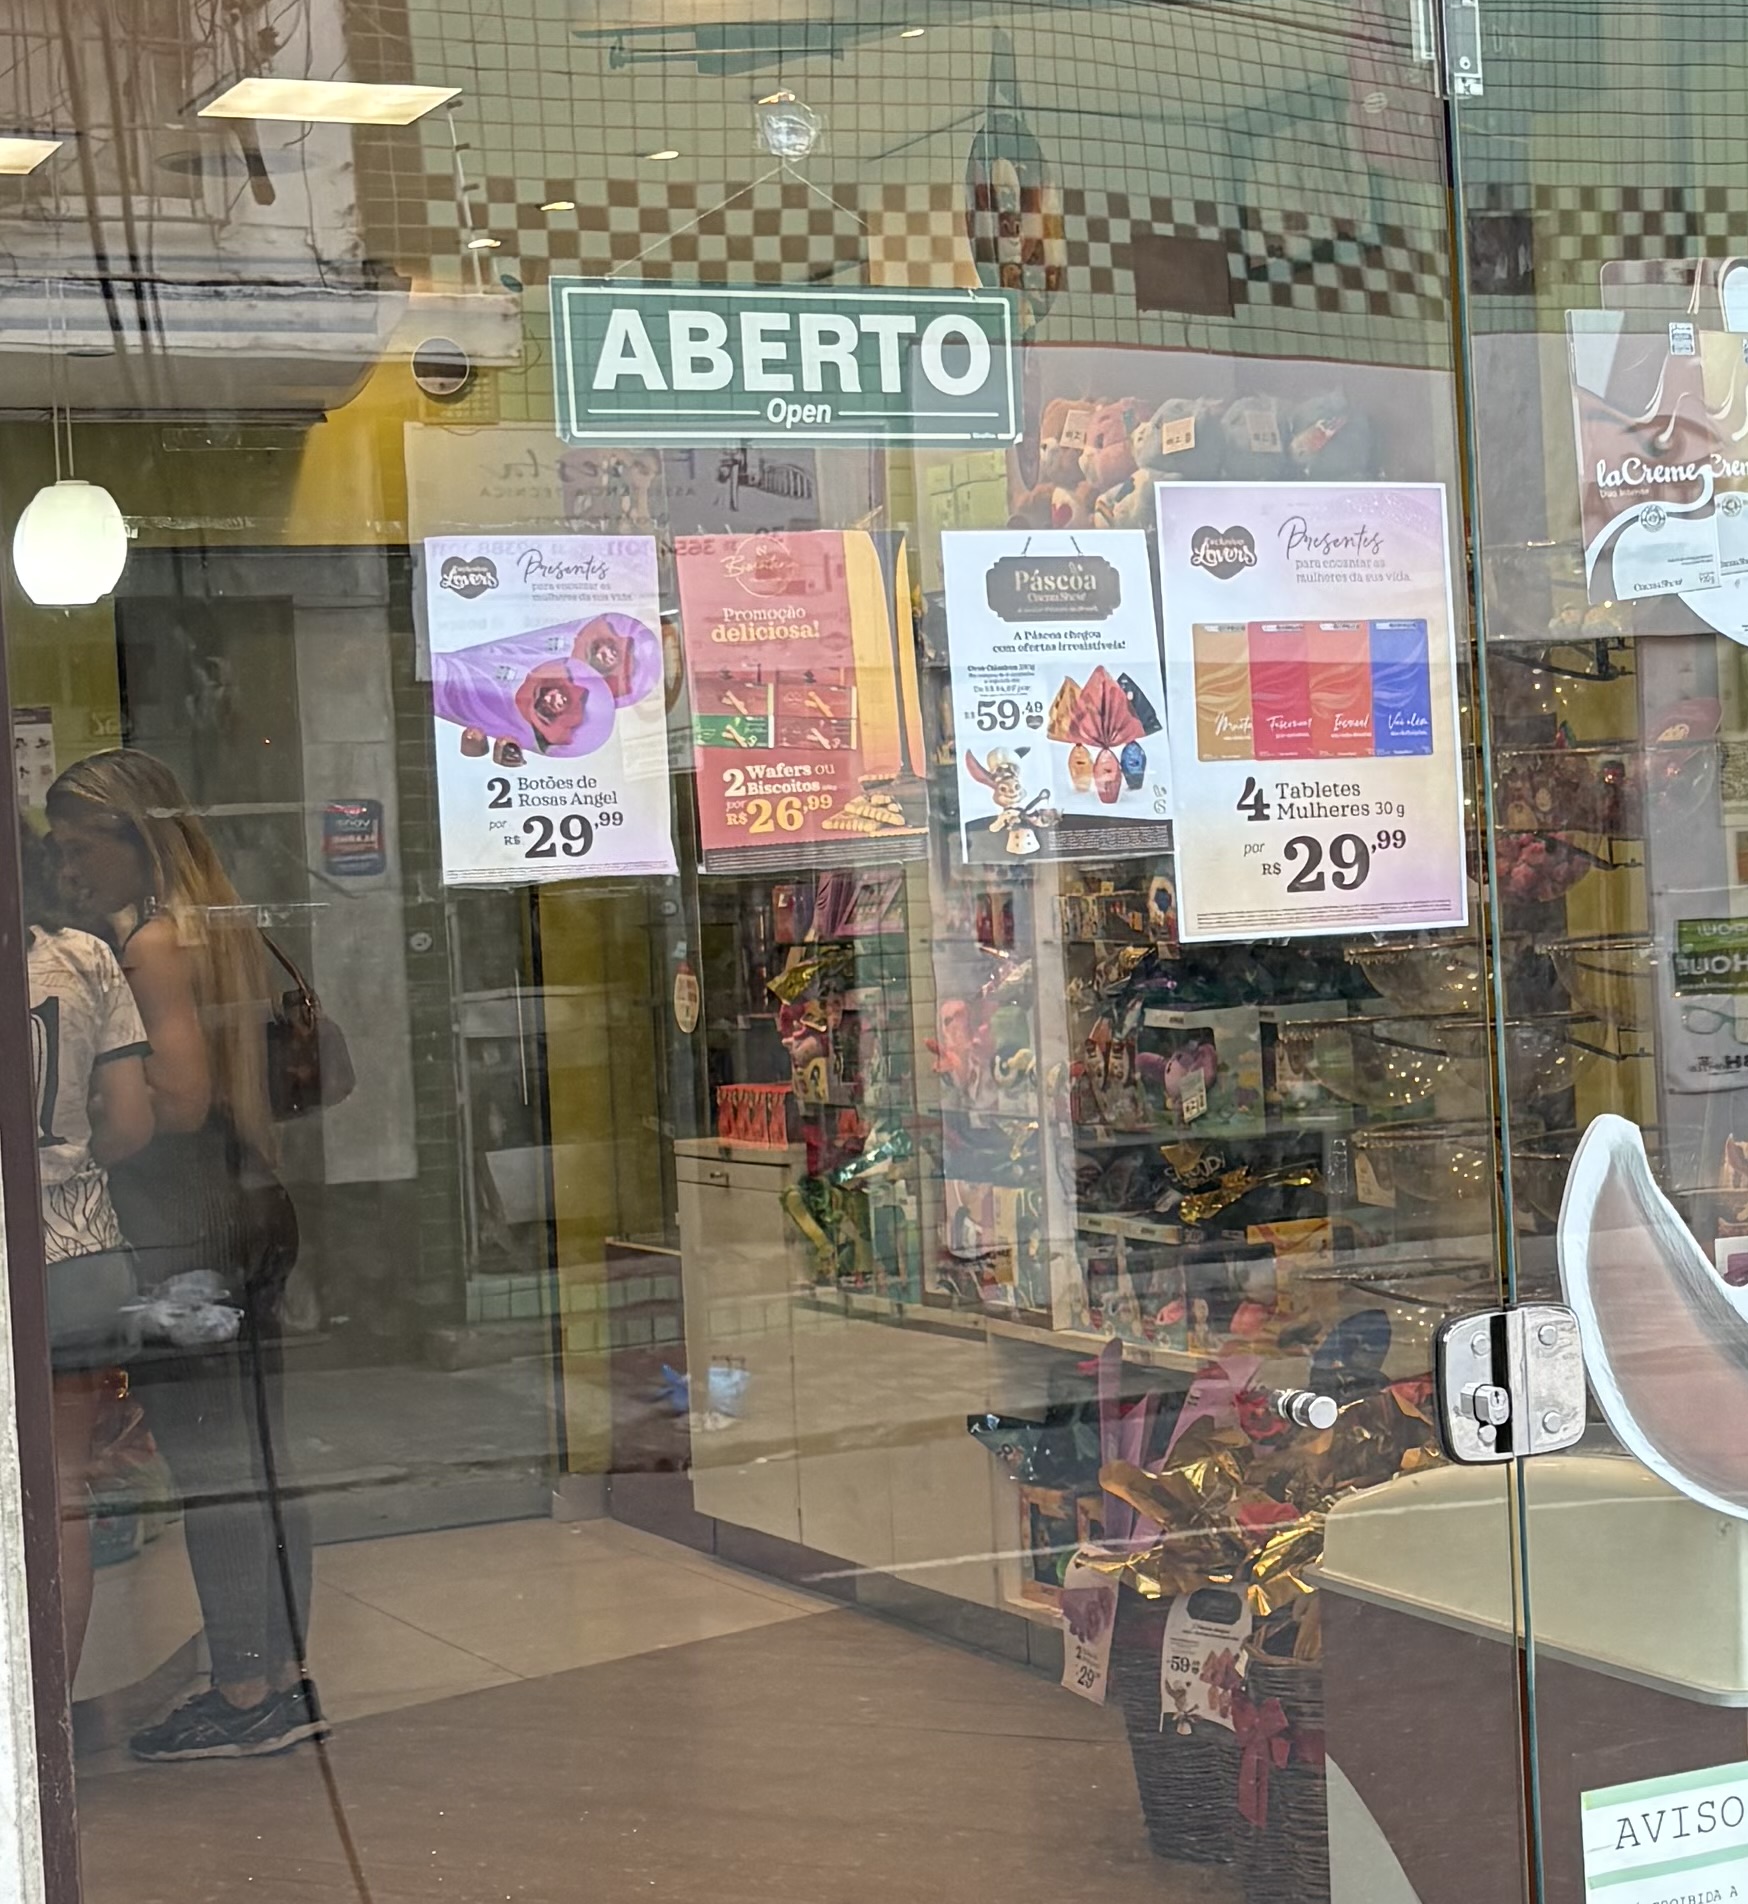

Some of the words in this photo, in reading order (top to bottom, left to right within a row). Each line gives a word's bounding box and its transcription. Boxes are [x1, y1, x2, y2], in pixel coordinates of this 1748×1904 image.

[591, 309, 991, 395] ABERTO
[767, 398, 832, 428] Open
[1277, 515, 1384, 560] Presentes
[1192, 542, 1257, 567] Lovers
[517, 549, 609, 583] Presentes
[1015, 567, 1097, 593] Páscoa
[723, 605, 806, 623] Promoção
[711, 620, 819, 643] deliciosa!
[746, 763, 811, 779] Wafers
[815, 764, 835, 775] ou
[518, 776, 573, 790] Botões
[577, 775, 597, 788] de
[723, 768, 746, 797] 2
[747, 780, 820, 795] Biscoitos
[1275, 781, 1361, 799] Tabletes
[487, 777, 512, 808] 2
[518, 794, 567, 807] Rosas
[571, 791, 618, 807] Angel
[1237, 776, 1270, 821] 4
[726, 799, 747, 812] por
[1277, 800, 1370, 820] Mulheres
[1375, 801, 1393, 815] 30
[489, 819, 508, 831] por
[727, 812, 748, 826] R$
[504, 835, 520, 846] R$
[1243, 841, 1265, 857] por
[1262, 862, 1281, 876] R$
[1615, 1796, 1745, 1851] AVISO
[1729, 1885, 1739, 1898] A
